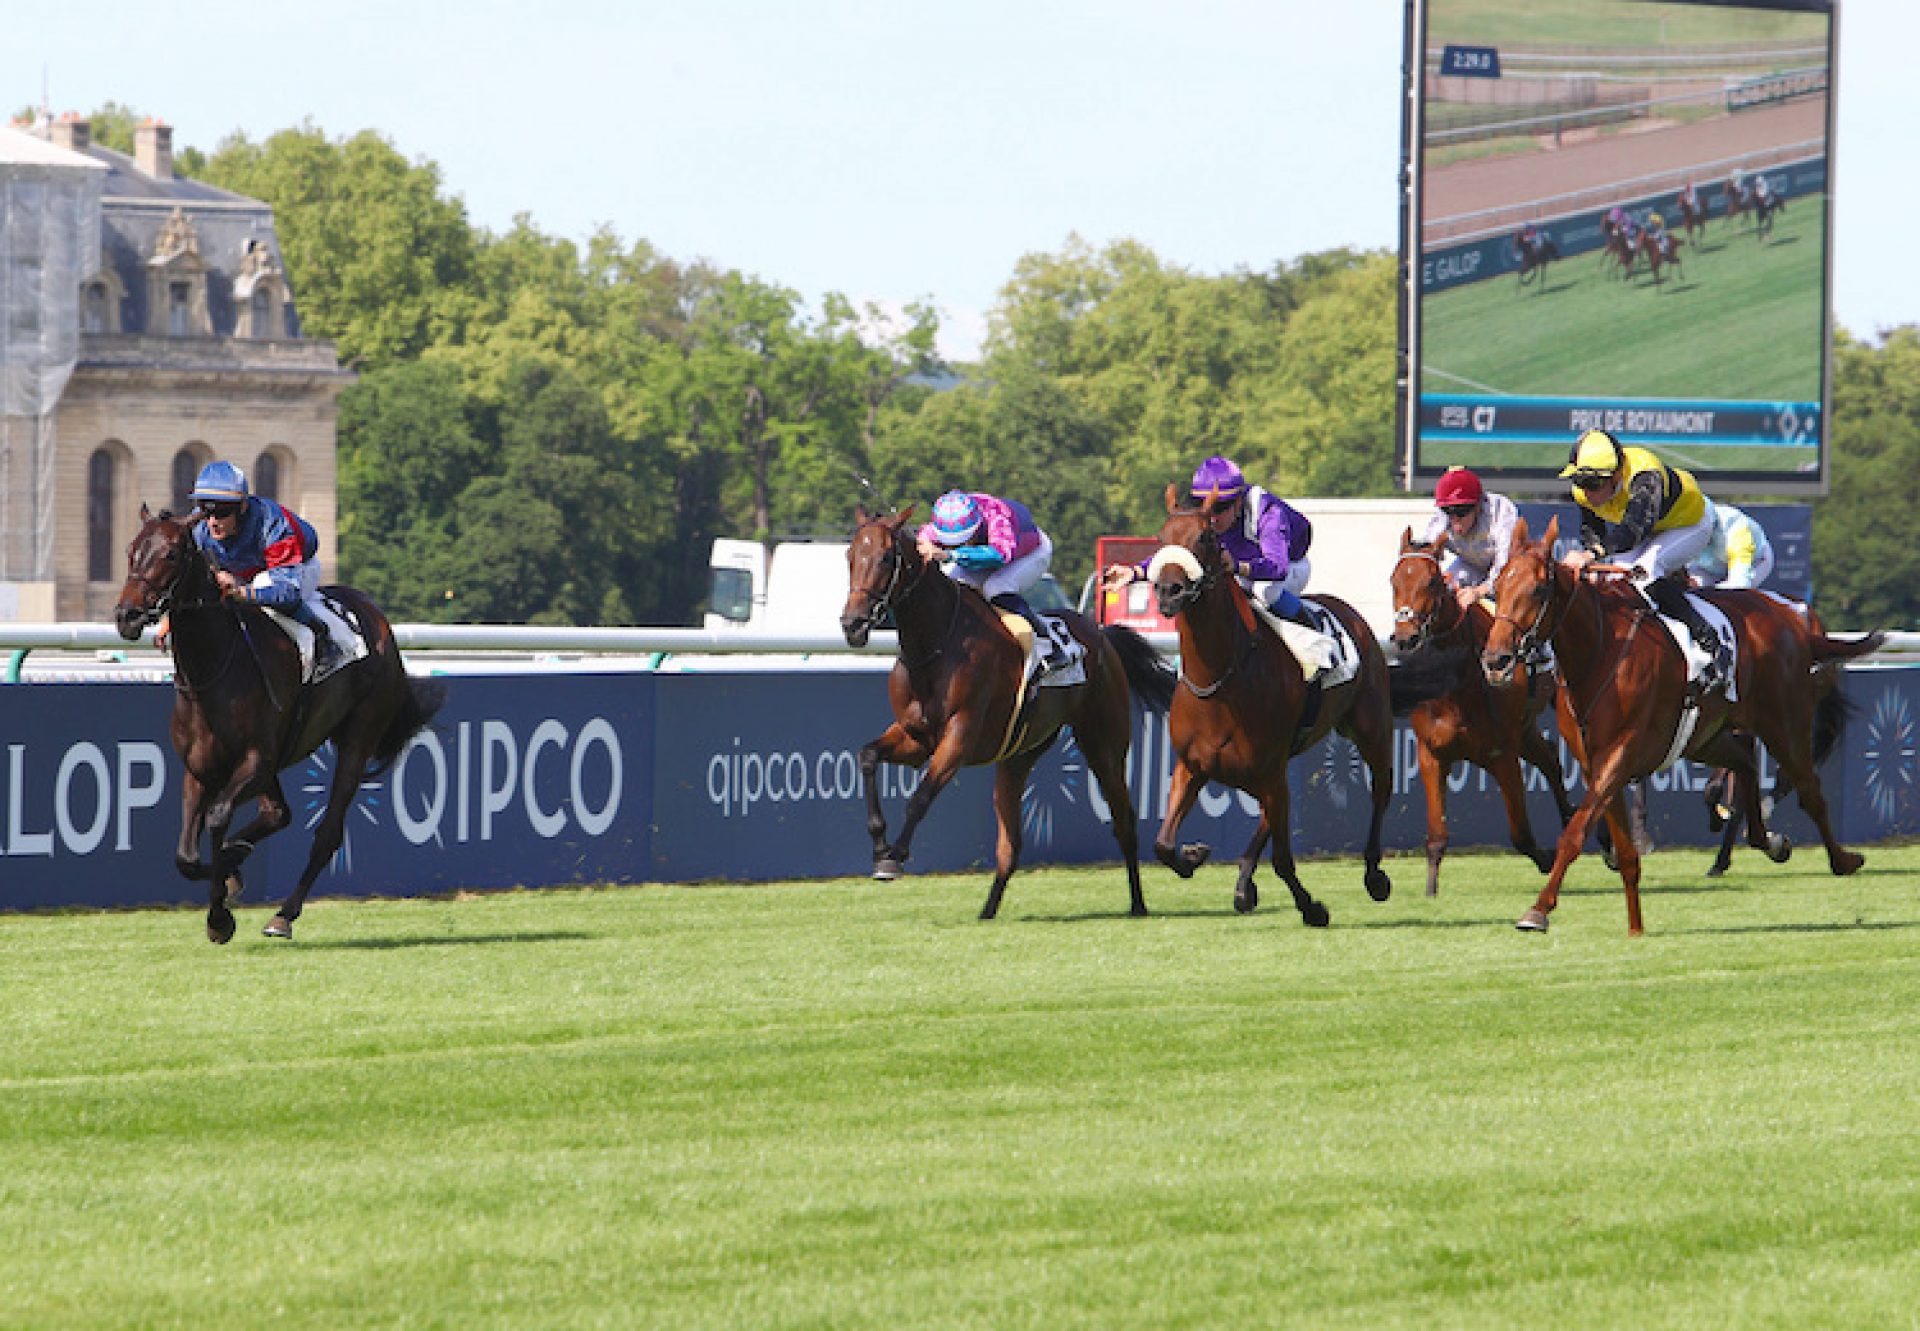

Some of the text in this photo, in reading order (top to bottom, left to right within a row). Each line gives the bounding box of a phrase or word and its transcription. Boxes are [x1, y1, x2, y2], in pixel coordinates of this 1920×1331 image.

[1605, 410, 1623, 432] DE
[1626, 410, 1714, 433] ROYAUMONT
[0, 740, 166, 857] LOP
[391, 716, 623, 849] QIPCO
